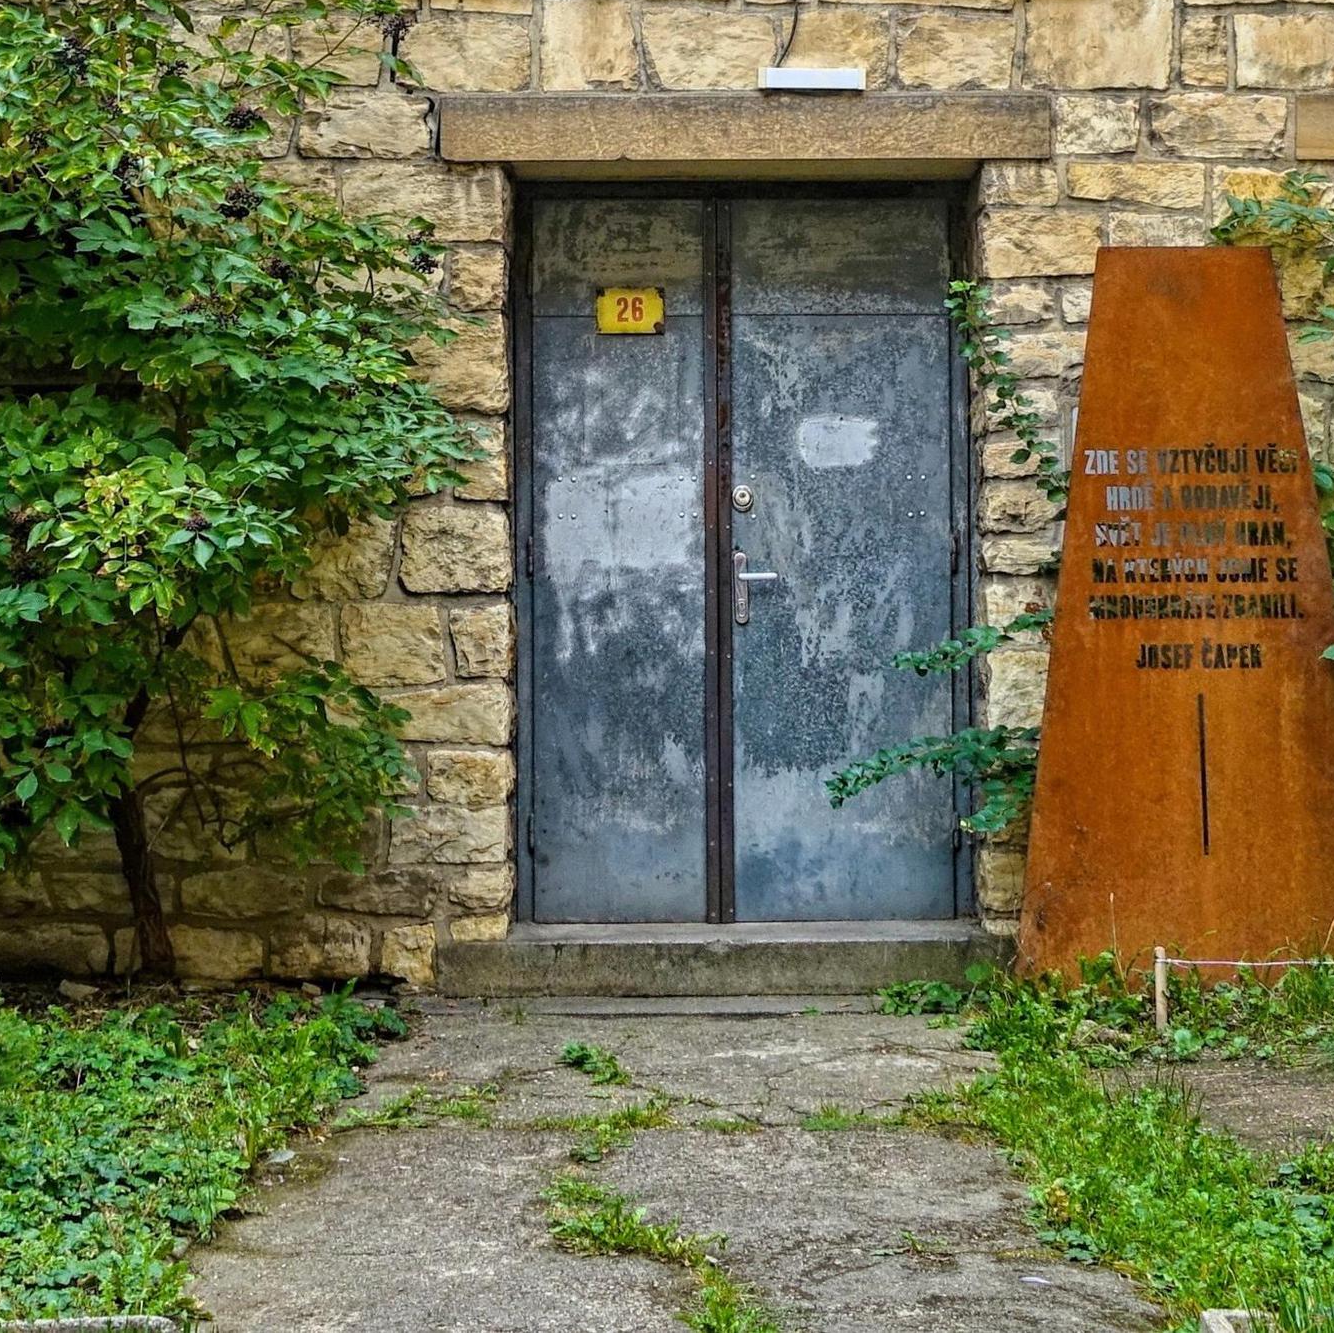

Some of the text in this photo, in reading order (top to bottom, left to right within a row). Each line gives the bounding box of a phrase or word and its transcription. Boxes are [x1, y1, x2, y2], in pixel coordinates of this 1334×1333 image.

[616, 296, 644, 323] 26
[1084, 449, 1119, 475] ZDE
[1126, 449, 1148, 475] SE
[1091, 557, 1117, 583] NA
[1275, 557, 1299, 583] SE
[1136, 637, 1263, 669] JOSEF ČAPEK
